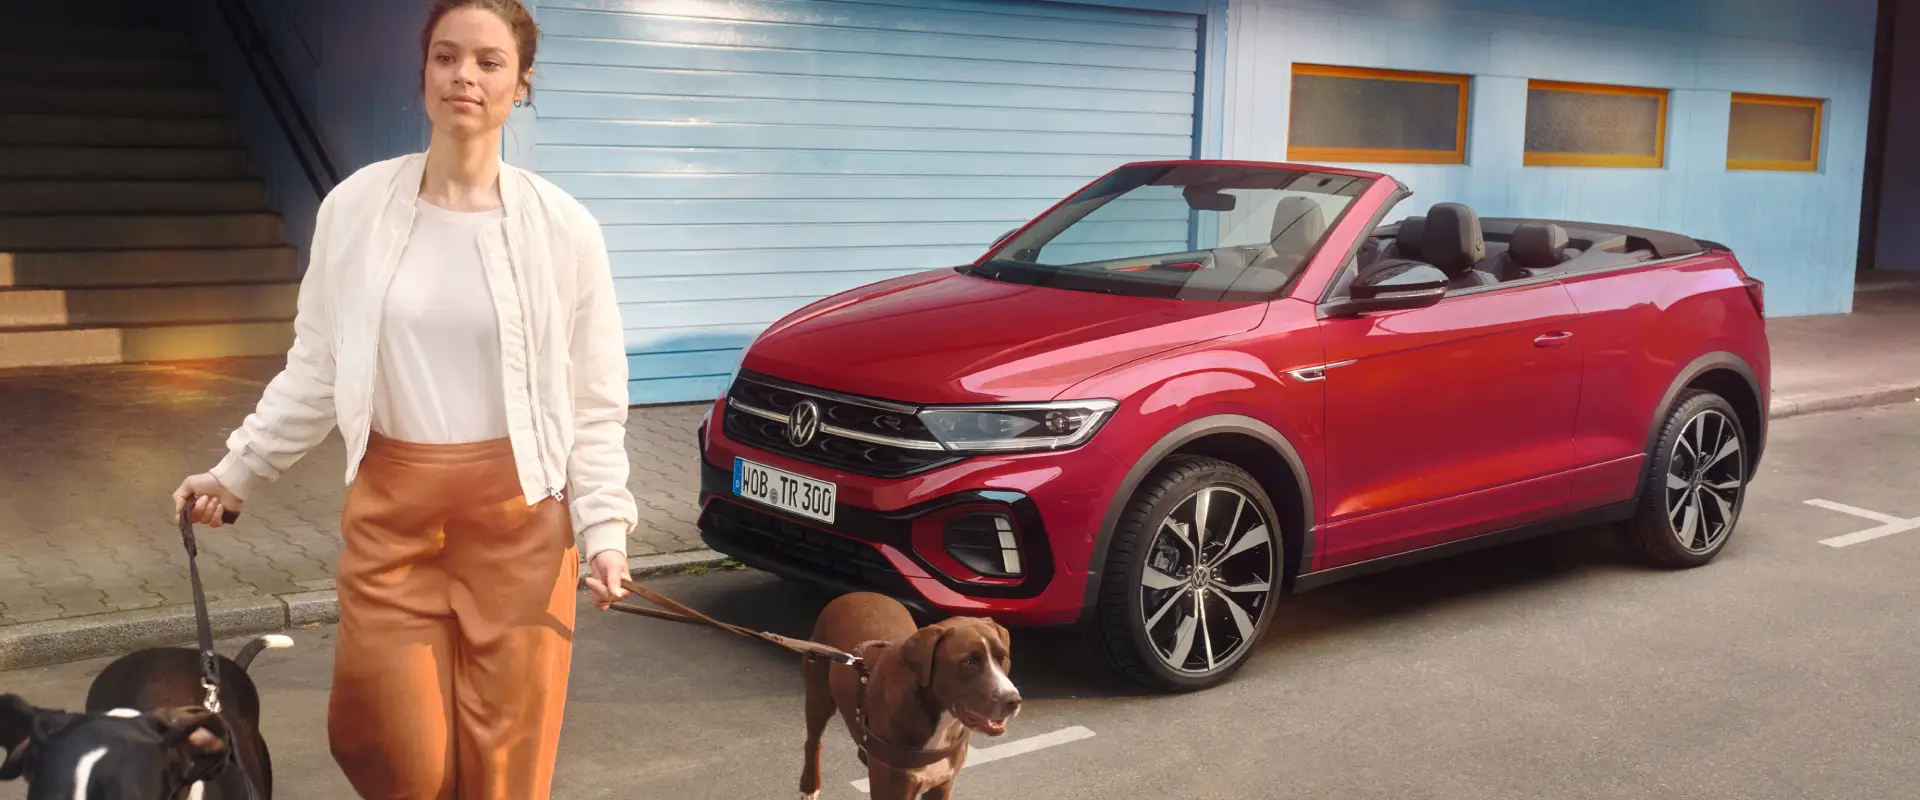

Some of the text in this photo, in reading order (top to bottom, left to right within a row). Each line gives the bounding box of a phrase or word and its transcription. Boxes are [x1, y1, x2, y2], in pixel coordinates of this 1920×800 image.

[789, 402, 816, 445] VW
[742, 466, 832, 517] WOB TR 300
